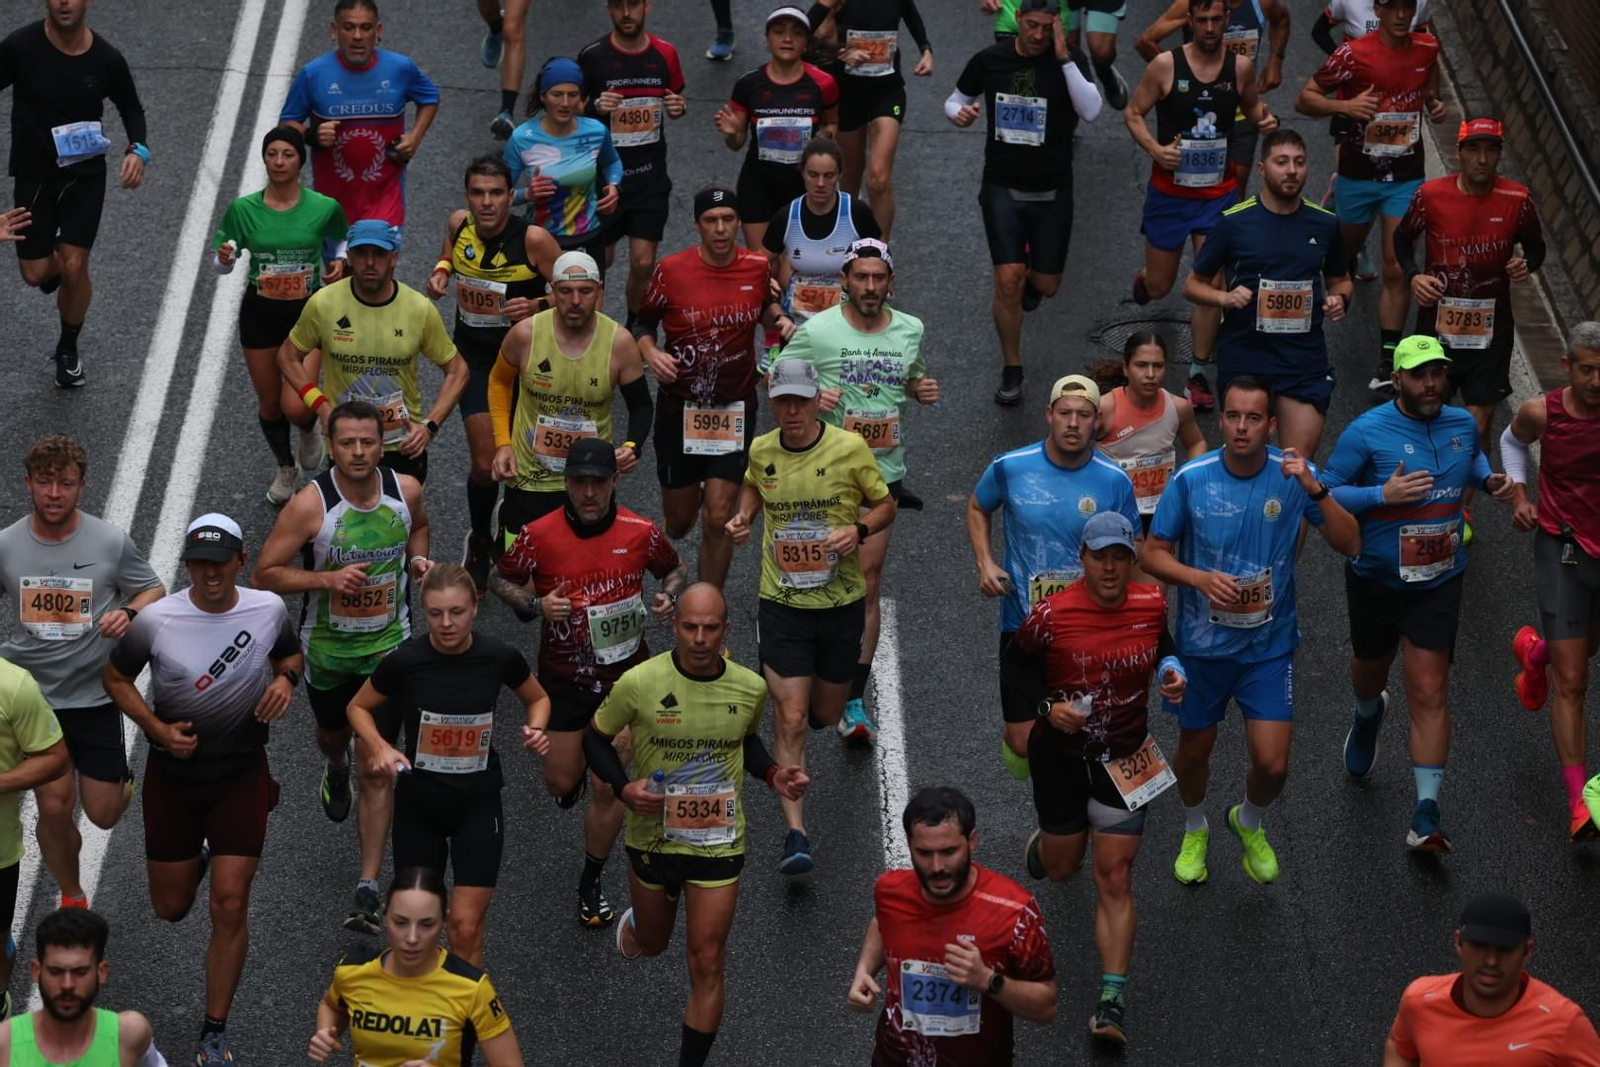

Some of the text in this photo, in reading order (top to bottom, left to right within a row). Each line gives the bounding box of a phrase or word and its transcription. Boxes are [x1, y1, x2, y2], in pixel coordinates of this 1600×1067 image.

[606, 78, 662, 88] PRORUNNERS
[329, 102, 395, 116] CREDUS
[619, 109, 651, 126] 4380
[1002, 106, 1036, 124] 2714
[1182, 151, 1218, 168] 1836
[461, 288, 495, 309] 6105
[800, 289, 837, 308] 5717
[1265, 294, 1302, 311] 5980
[1444, 310, 1482, 327] 3783
[840, 347, 903, 360] Bank of America
[341, 365, 400, 377] MIRAFLORES
[866, 388, 880, 399] 24
[693, 415, 731, 431] 5994
[852, 421, 889, 441] 5687
[544, 430, 584, 451] 533
[1131, 466, 1166, 489] 4322
[782, 545, 822, 563] 5315
[31, 593, 75, 613] 4802
[341, 590, 382, 608] 5852
[600, 613, 638, 638] 9751
[655, 716, 682, 726] valora
[430, 729, 477, 748] 5619
[649, 736, 694, 751] AMIGOS
[662, 749, 729, 764] MIRAFLORES
[1118, 747, 1153, 781] 5237
[676, 800, 722, 819] 5334
[911, 979, 962, 1005] 2374
[351, 1009, 443, 1038] REDOLAT
